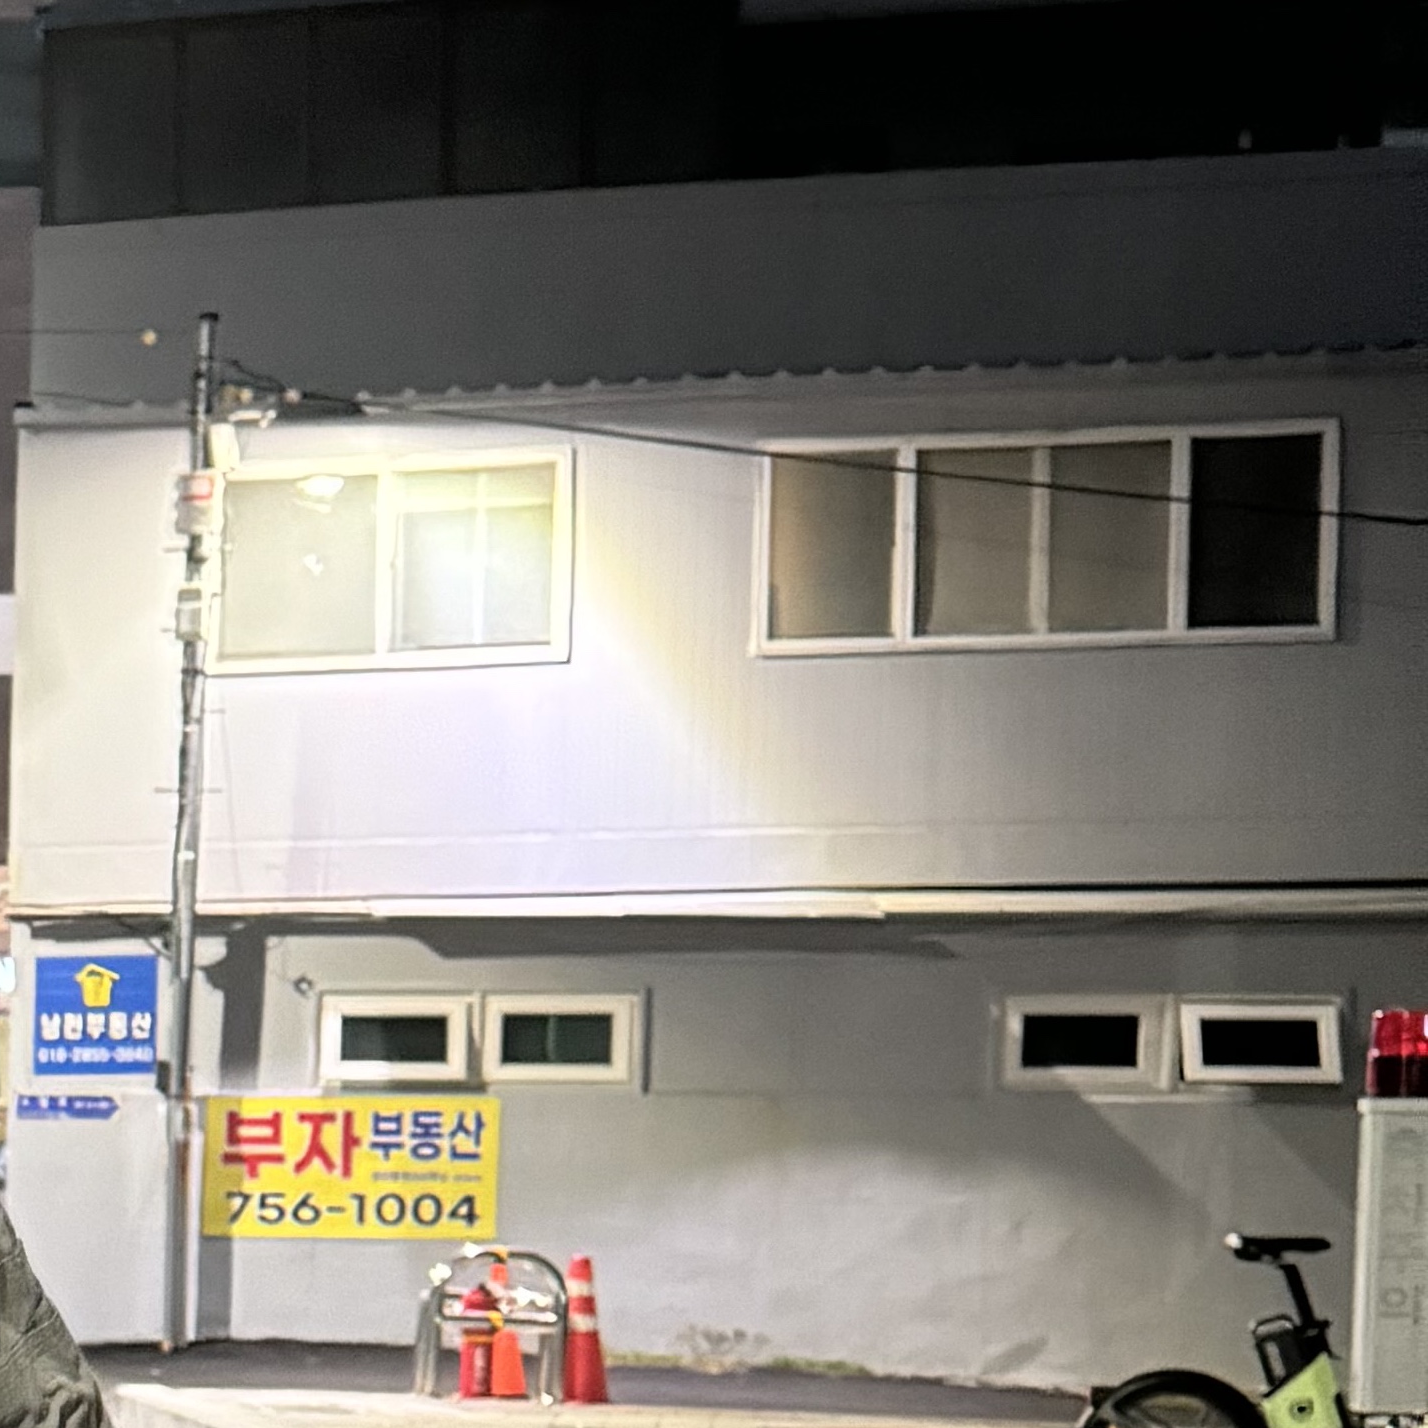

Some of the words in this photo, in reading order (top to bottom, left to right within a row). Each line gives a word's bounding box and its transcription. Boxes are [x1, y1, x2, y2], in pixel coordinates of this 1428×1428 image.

[221, 1110, 362, 1180] 부자
[369, 1110, 485, 1161] 부동산
[226, 1192, 480, 1228] 756-1004
